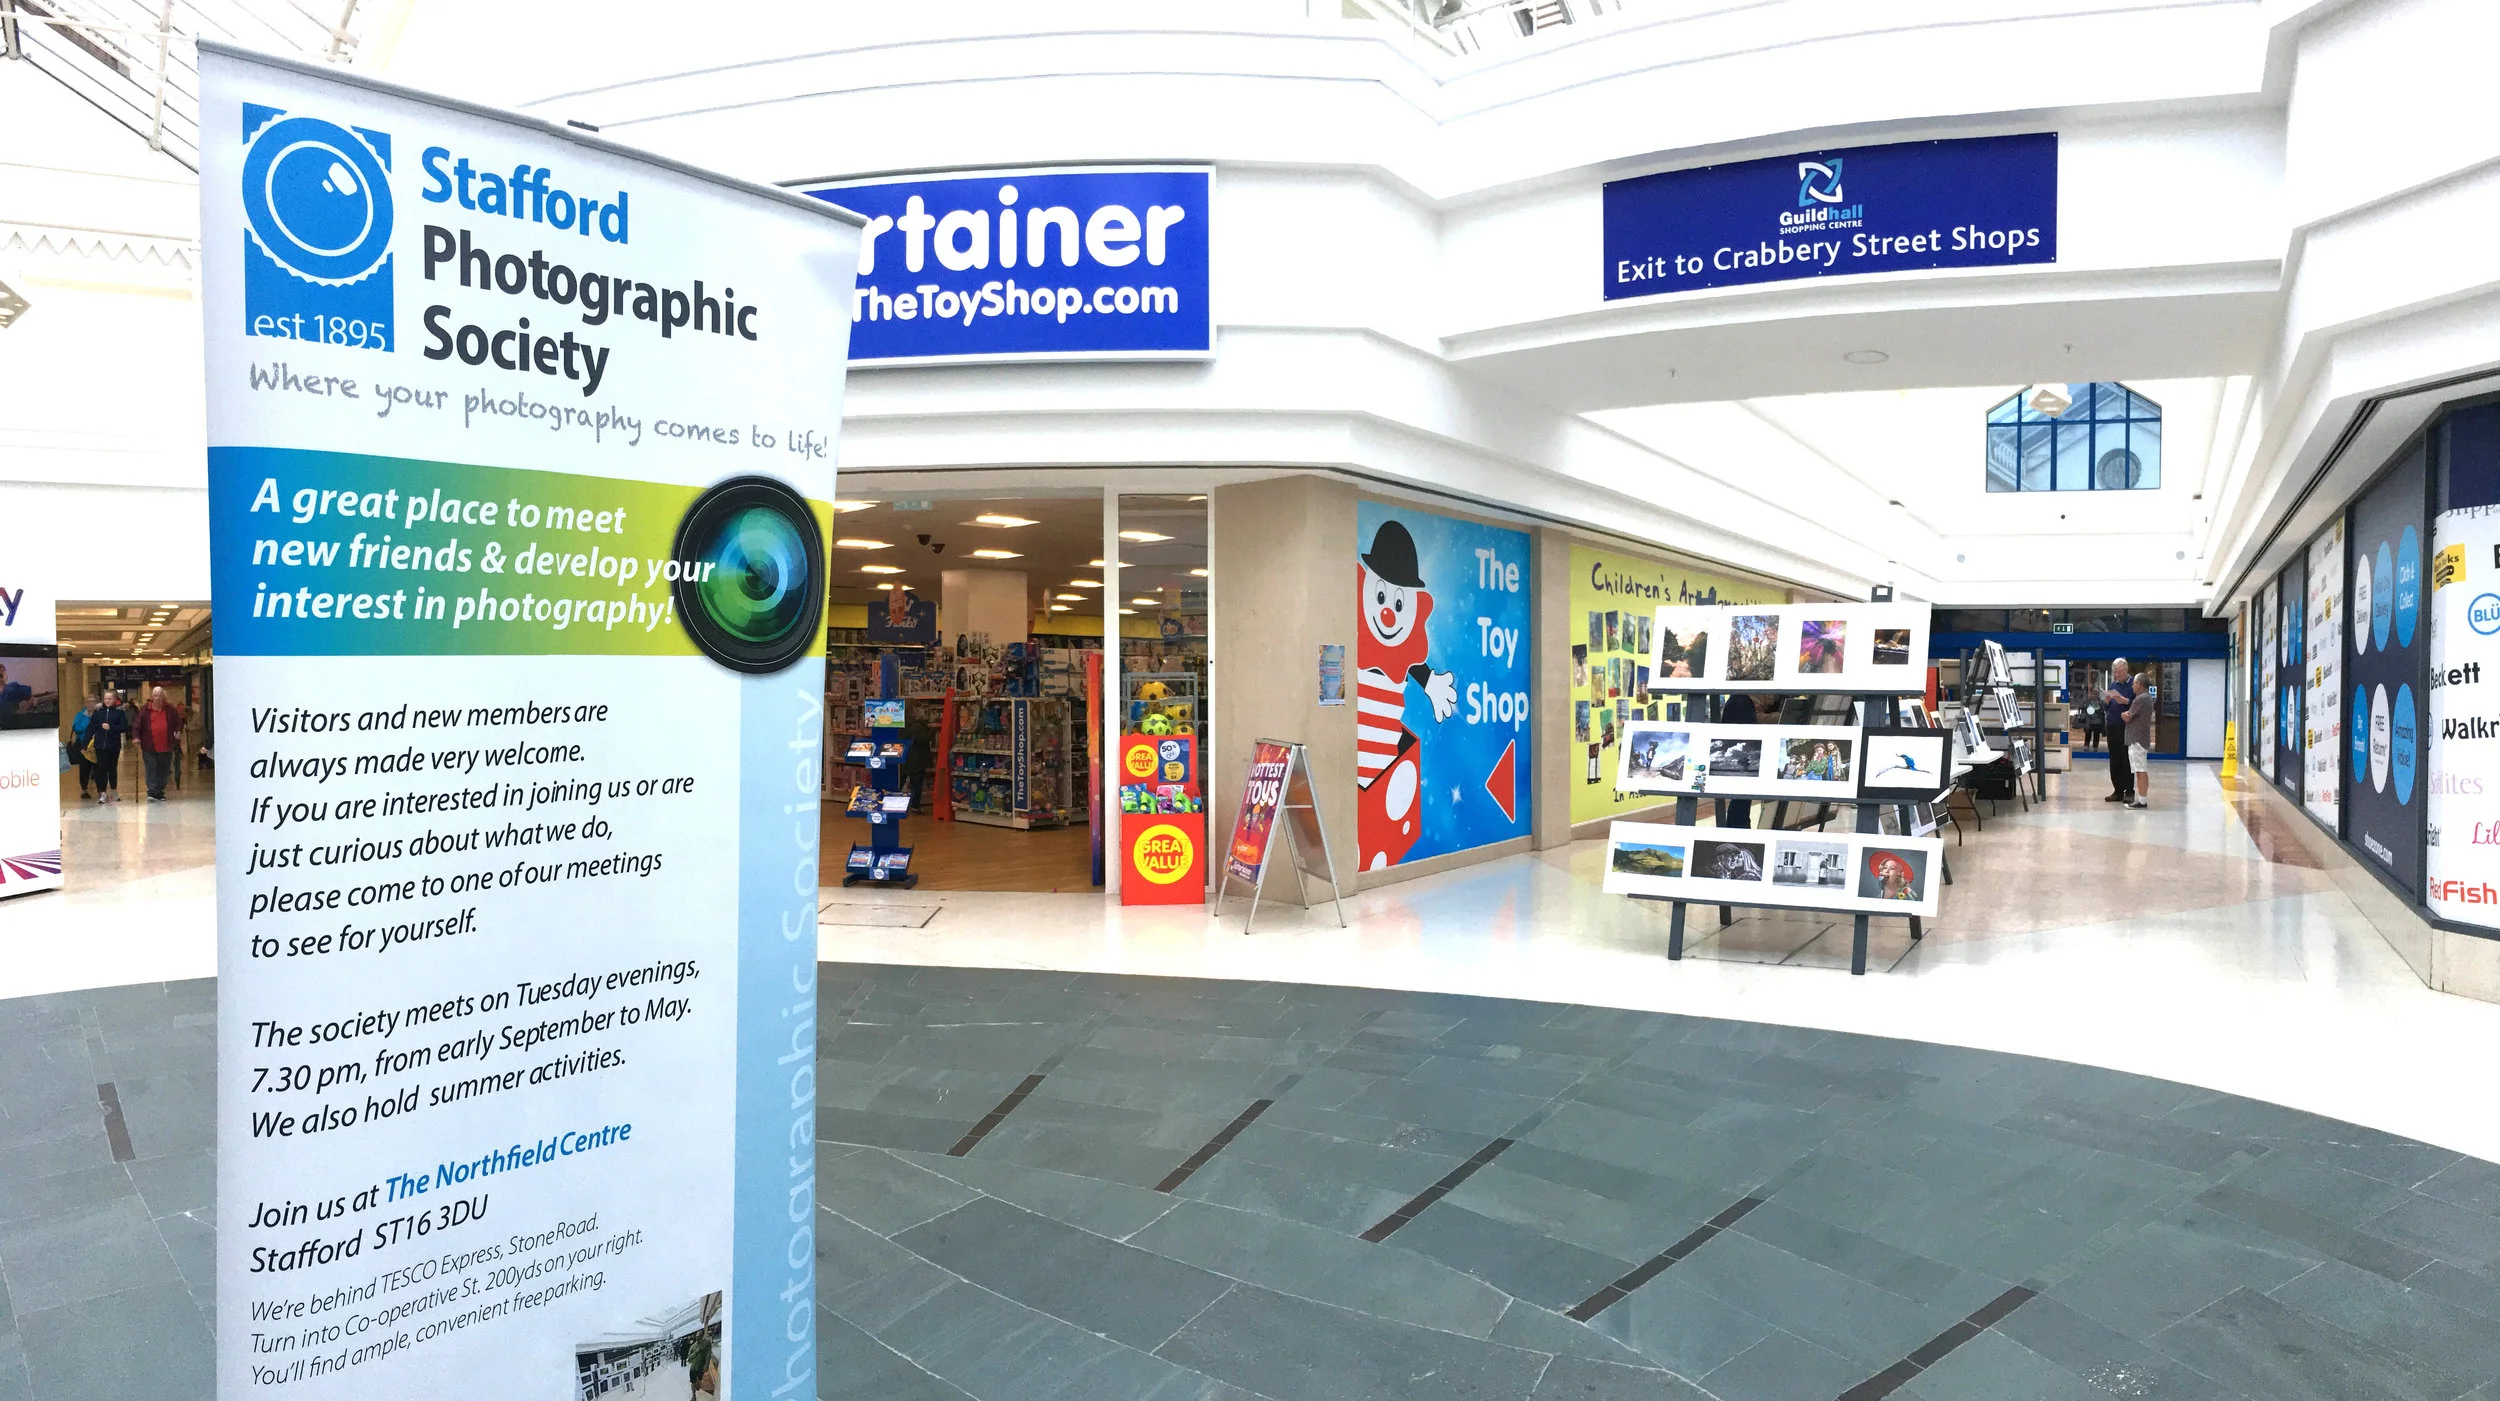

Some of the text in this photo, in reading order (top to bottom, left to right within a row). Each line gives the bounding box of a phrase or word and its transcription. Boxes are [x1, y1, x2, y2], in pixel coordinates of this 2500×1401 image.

[421, 146, 629, 245] Stafford
[1779, 204, 1863, 227] Guildhall
[1617, 224, 2041, 284] Exit to Crabbery Street Shops
[1779, 218, 1863, 235] SHOPPING CENTRE
[423, 224, 758, 342] Photographic
[852, 279, 1178, 327] TheToyShop.com
[254, 315, 386, 351] est 1895
[423, 305, 610, 397] Society
[250, 361, 829, 459] Where your photography comes to life!
[250, 477, 627, 534] A great place to meet
[252, 532, 717, 589] new friends & develop your
[1475, 548, 1520, 593] The
[1592, 562, 1671, 602] Children's
[1679, 580, 1698, 605] Ar
[252, 582, 675, 633] interest in photography!
[1477, 615, 1519, 668] Toy
[2430, 661, 2481, 691] Beckett
[251, 701, 609, 734] Visitors and new members are
[1467, 681, 1530, 732] Shop
[2395, 723, 2414, 744] Amazing
[249, 741, 586, 784] always made very welcome.
[1017, 707, 1026, 802] TheToyShop.com
[1251, 763, 1285, 778] HOTTEST
[250, 774, 695, 830] If you are interested in joining us or are
[1246, 781, 1280, 806] TOYS
[246, 815, 613, 875] just curious about what we do,
[1139, 840, 1189, 853] GREAT
[1139, 856, 1189, 869] VALUE
[249, 851, 662, 920] please come to one of our meetings
[251, 907, 478, 959] to see for yourself.
[251, 957, 701, 1048] The society meets on Tuesday evenings,
[250, 995, 692, 1095] 7.30 pm, from early September to May.
[771, 688, 824, 1401] hotographic Society
[251, 1045, 627, 1139] We also hold summer activities.
[249, 1120, 632, 1229] Join us at The Northfield Centre
[250, 1193, 490, 1274] Stafford ST16 3DU
[251, 1211, 600, 1322] We're behind TESCO Express, Stone Road.
[251, 1227, 644, 1355] Turn into Co-operative St. 200yds on your right.
[251, 1269, 607, 1387] You'll find ample, convenient free parking.
